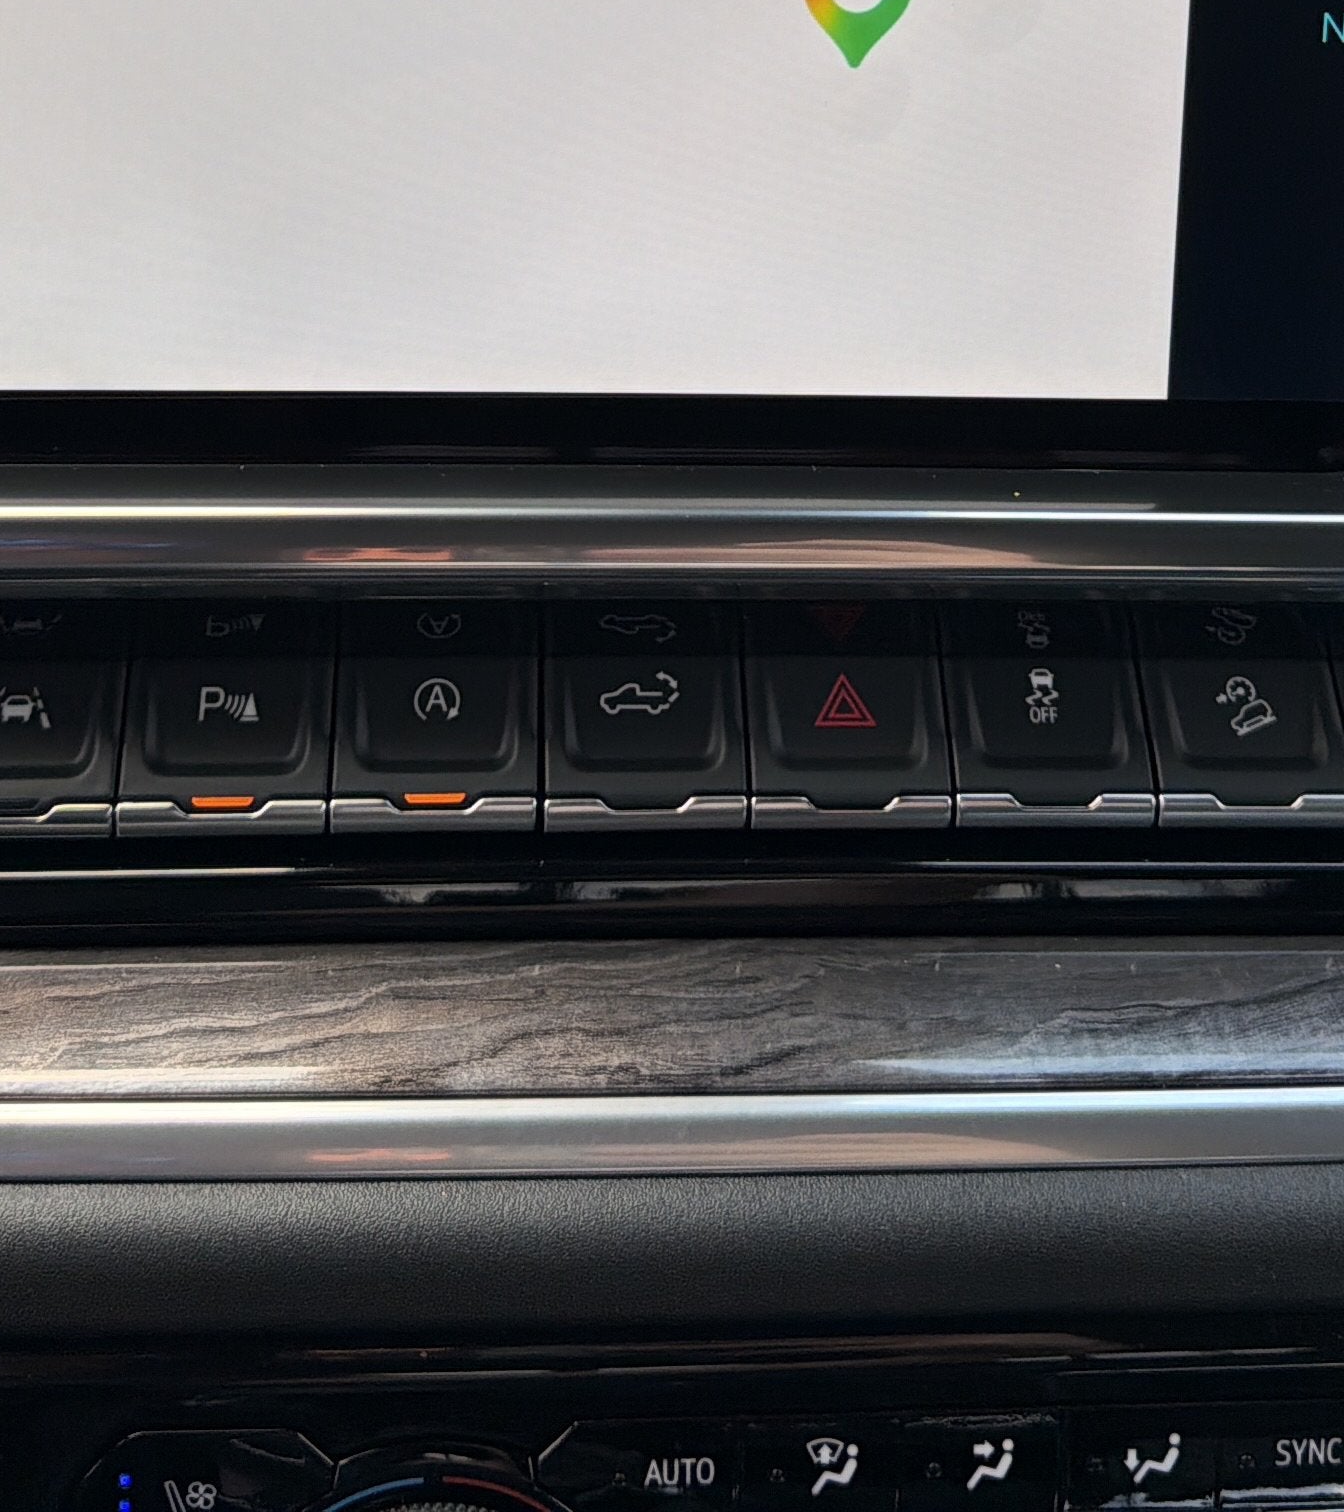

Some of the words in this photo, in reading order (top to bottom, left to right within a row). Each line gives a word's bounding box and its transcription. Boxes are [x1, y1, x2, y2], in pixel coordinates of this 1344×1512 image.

[1029, 706, 1058, 724] OFF
[1274, 1437, 1343, 1466] SYNC
[643, 1457, 716, 1487] AUTO
